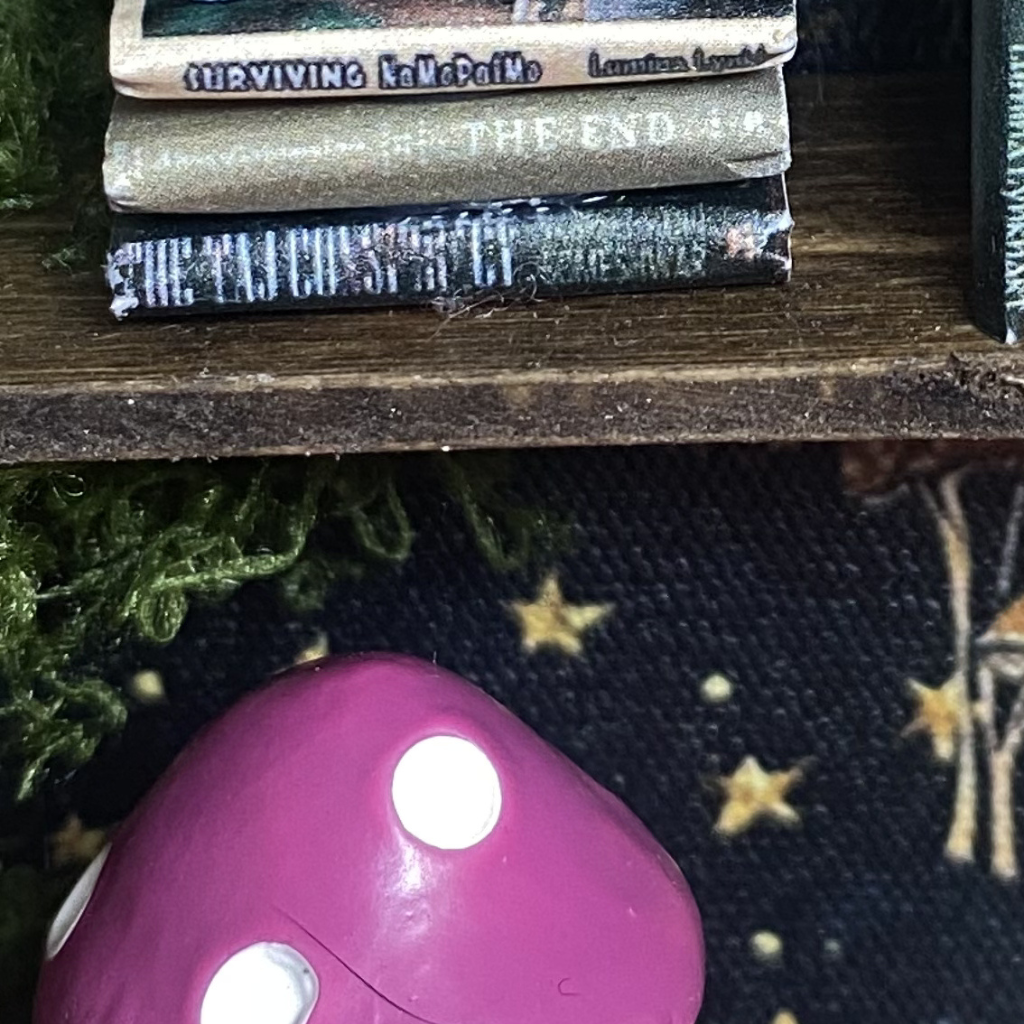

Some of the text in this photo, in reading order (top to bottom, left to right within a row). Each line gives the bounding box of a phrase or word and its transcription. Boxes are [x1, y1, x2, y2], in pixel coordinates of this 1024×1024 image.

[184, 62, 366, 92] SURVIVING
[464, 117, 558, 154] THE
[580, 110, 678, 150] END
